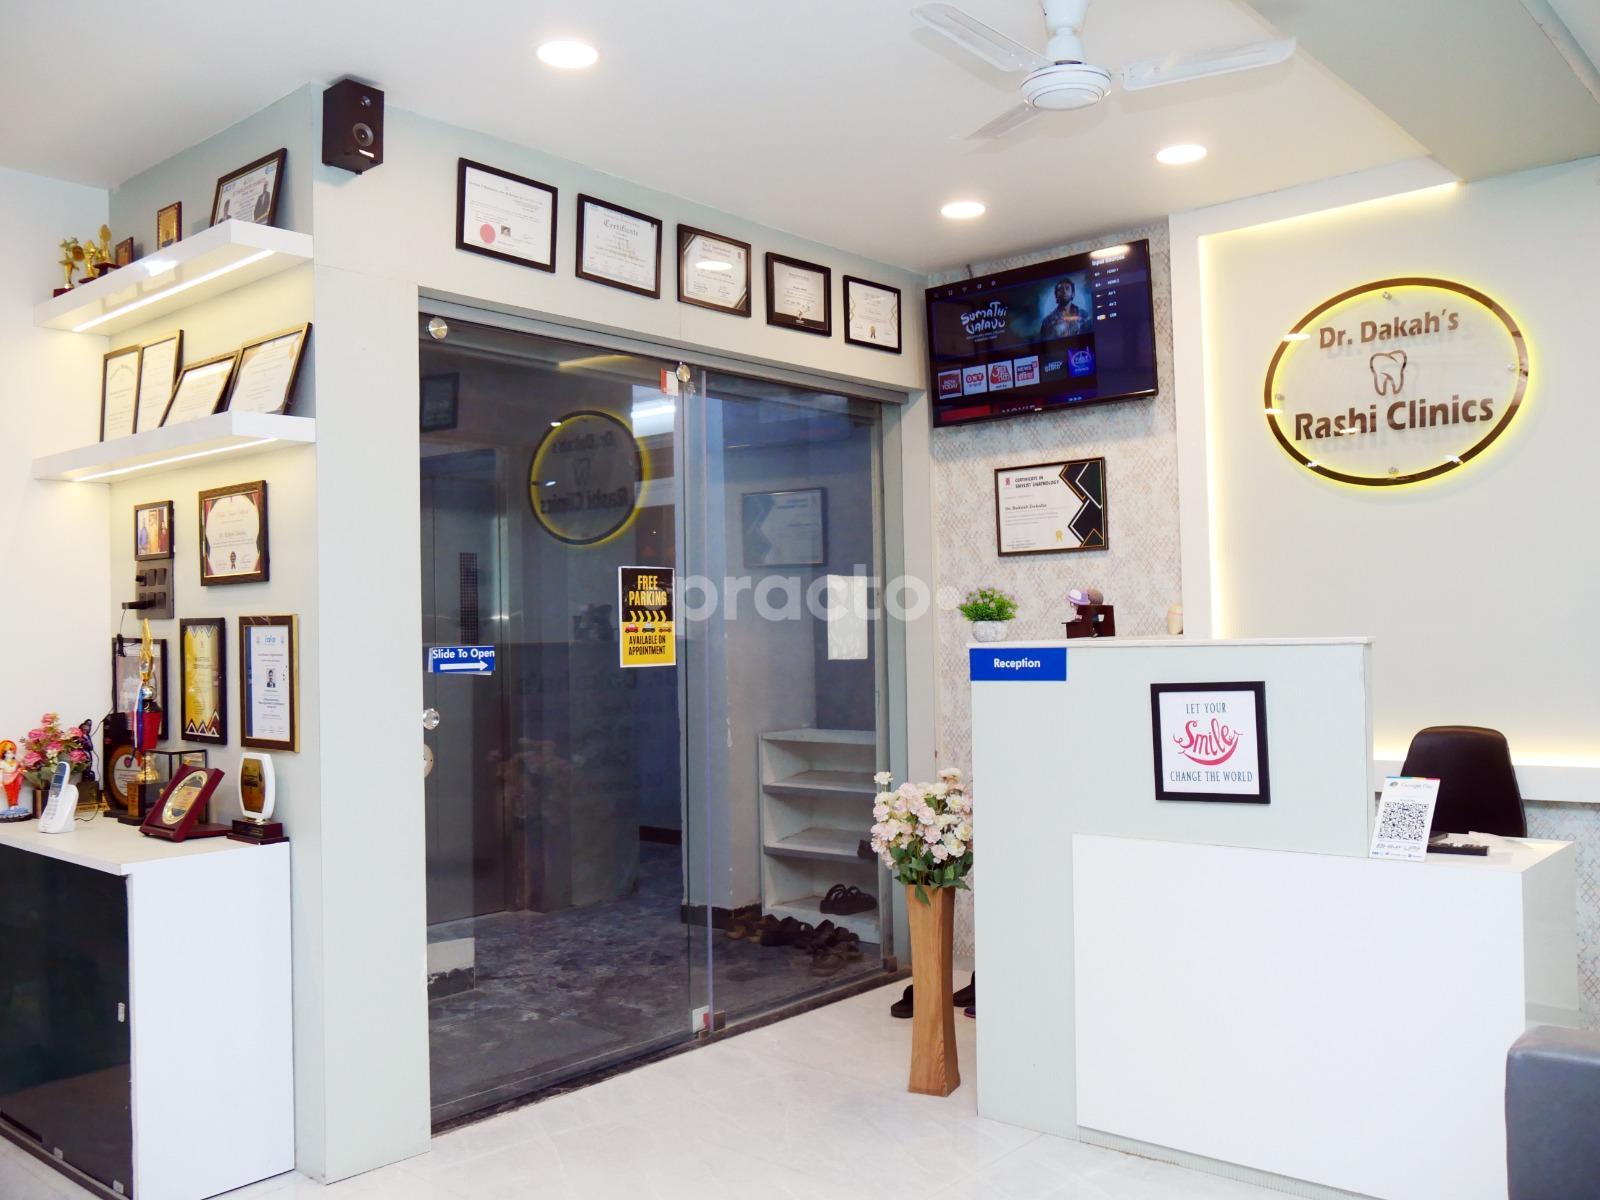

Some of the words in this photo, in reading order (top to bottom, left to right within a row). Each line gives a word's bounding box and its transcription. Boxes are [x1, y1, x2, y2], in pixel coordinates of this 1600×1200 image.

[1319, 326, 1353, 349] Dr.
[1360, 309, 1459, 343] Dakah's
[1295, 404, 1377, 440] Rashi
[1387, 395, 1494, 431] Clinics
[637, 575, 658, 590] FREE
[629, 590, 667, 606] PARKING
[629, 635, 658, 645] AVAILABLE
[658, 635, 666, 644] ON
[432, 648, 455, 659] Slide
[457, 648, 468, 658] To
[470, 648, 495, 660] Open
[628, 645, 666, 656] APPOINTMENT
[993, 658, 1041, 671] Reception
[1186, 703, 1200, 714] LET
[1205, 702, 1227, 713] YOUR
[1173, 718, 1238, 757] Smile
[1170, 771, 1202, 782] CHANGE
[1205, 771, 1221, 782] THE
[1223, 771, 1253, 782] WORLD
